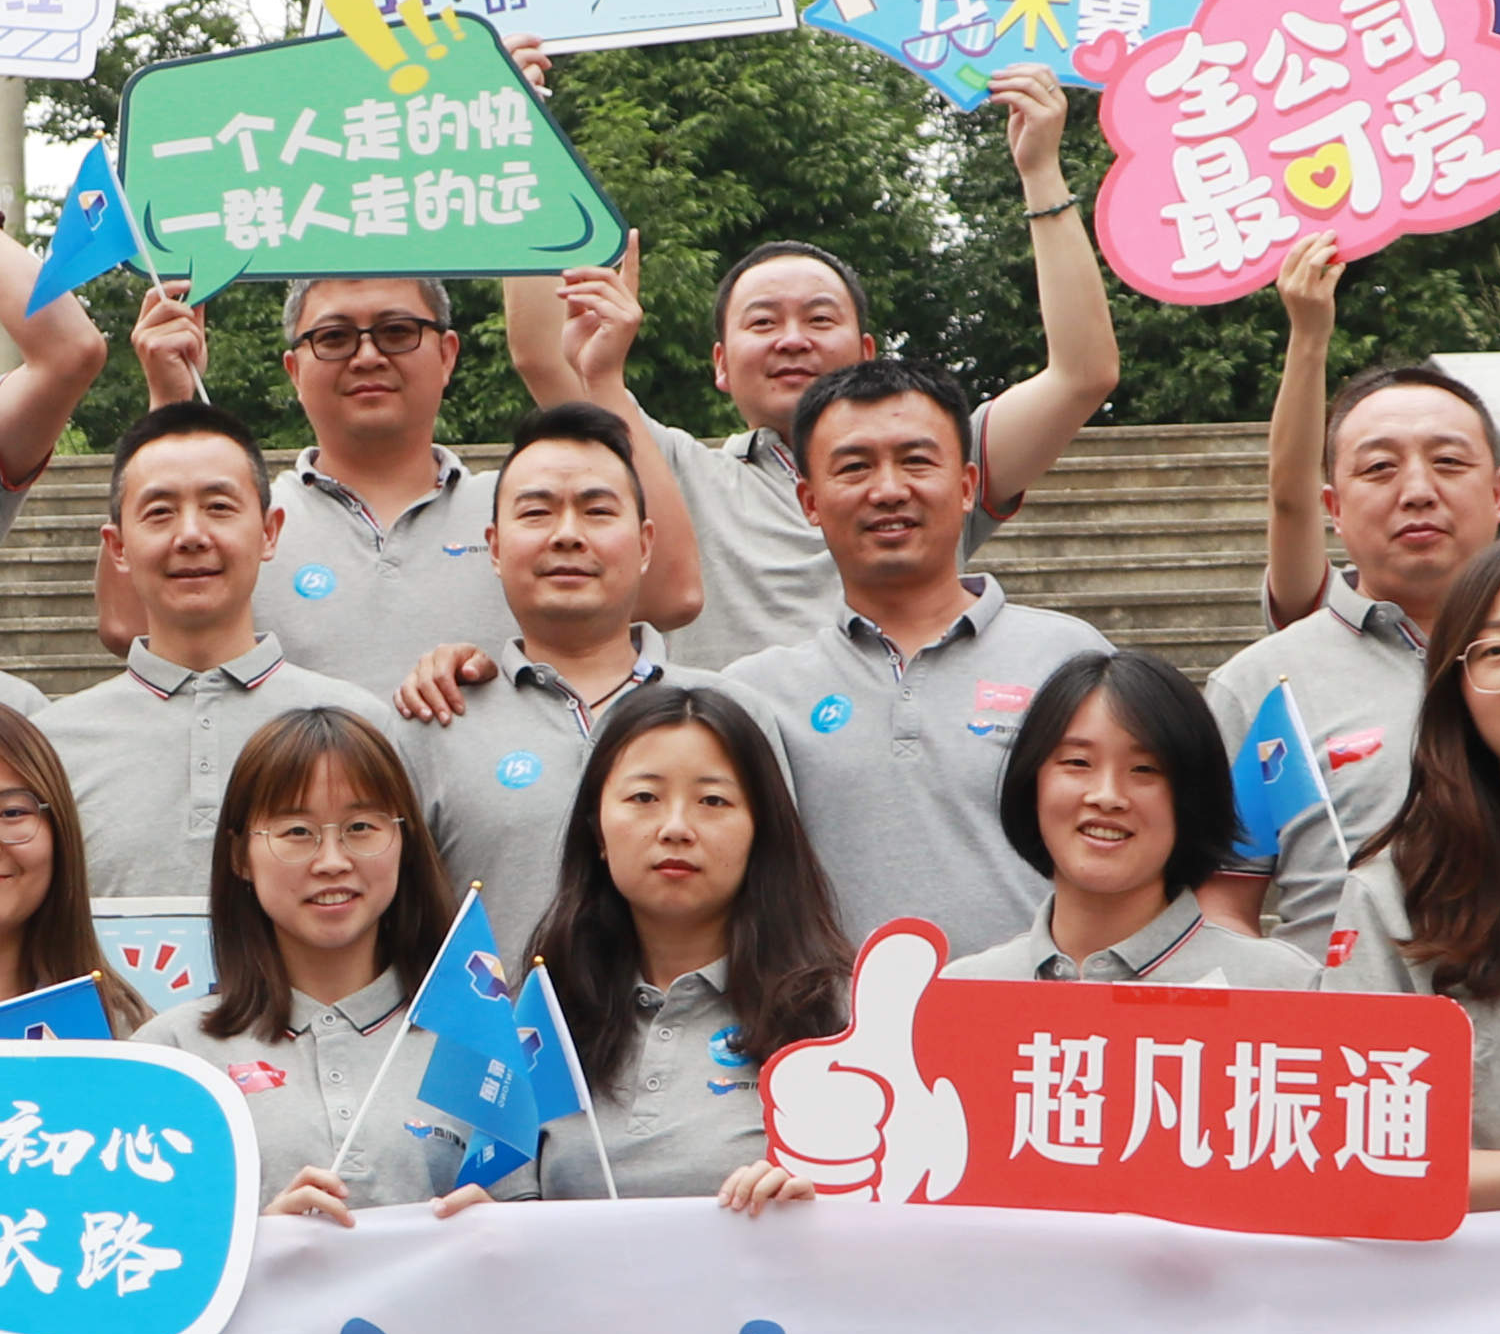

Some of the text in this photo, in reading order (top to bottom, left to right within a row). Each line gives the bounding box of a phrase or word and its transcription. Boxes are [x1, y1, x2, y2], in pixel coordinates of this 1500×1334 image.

[152, 85, 534, 174] 一个人走的快
[160, 160, 541, 251] 一群人走的远
[1008, 1031, 1432, 1178] 超凡振通
